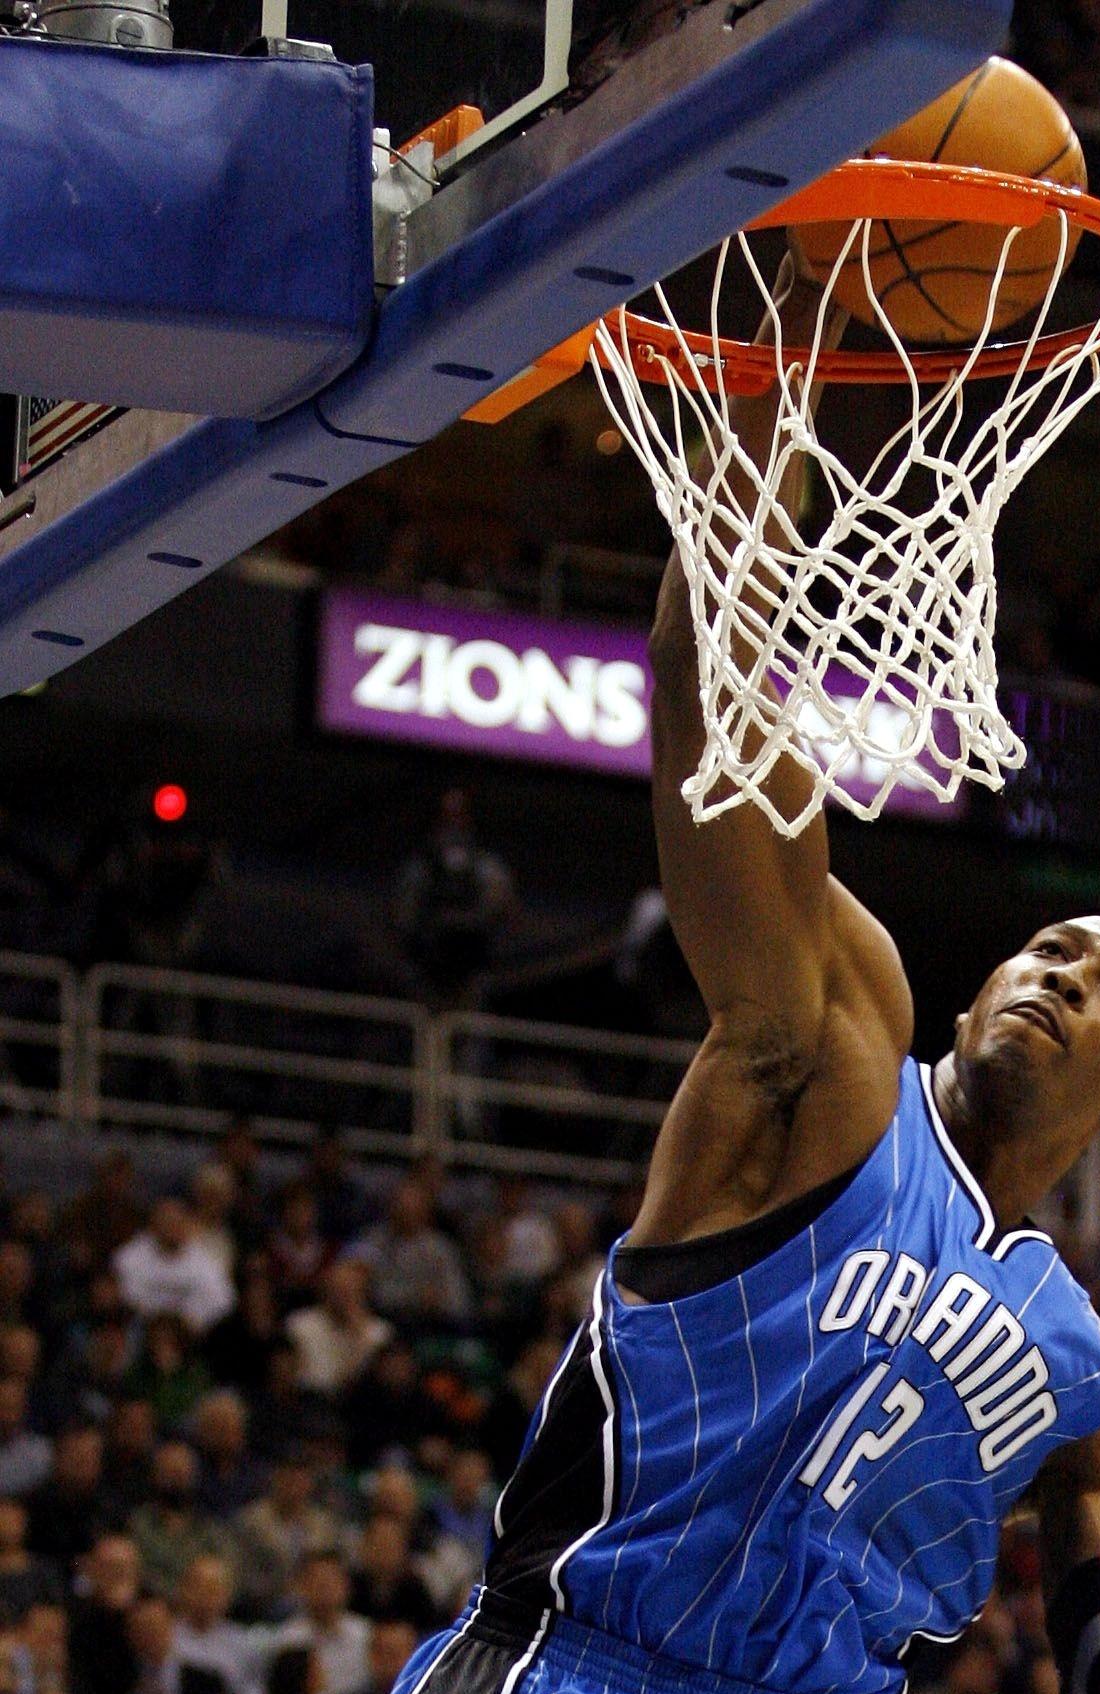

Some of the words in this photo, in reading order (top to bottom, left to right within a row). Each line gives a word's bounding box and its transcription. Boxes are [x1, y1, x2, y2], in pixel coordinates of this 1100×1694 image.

[353, 622, 647, 748] ZIONS
[817, 1247, 1060, 1474] ORANDO
[797, 1361, 926, 1512] 12
